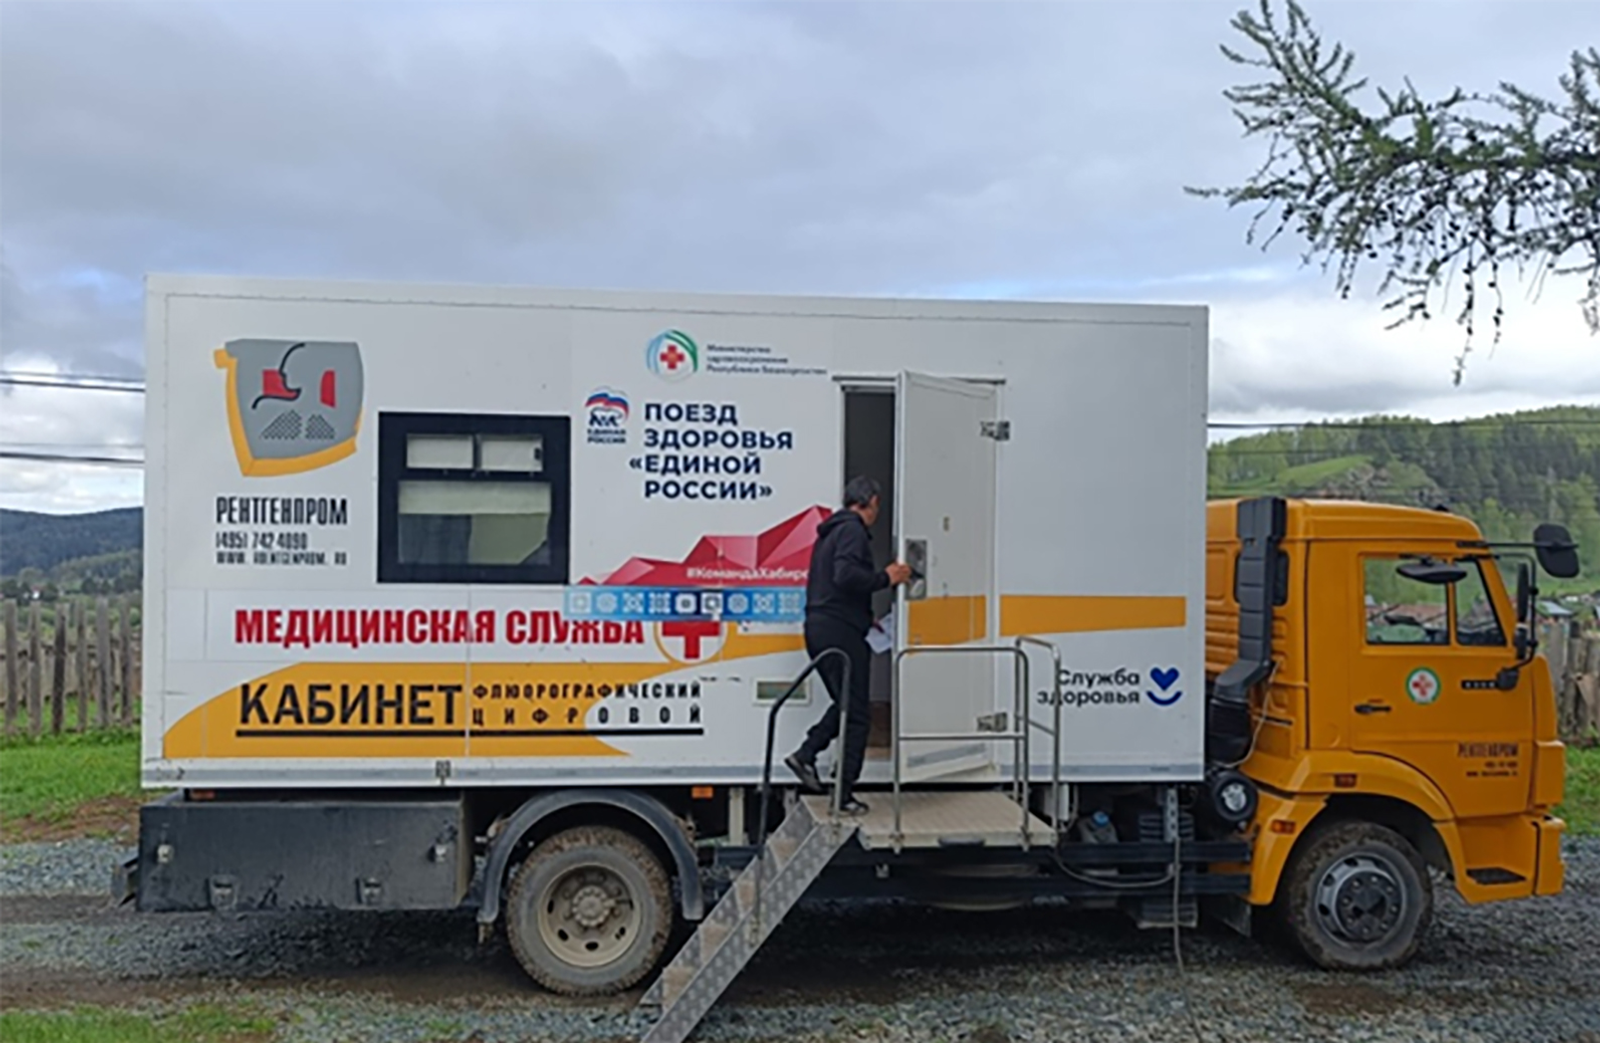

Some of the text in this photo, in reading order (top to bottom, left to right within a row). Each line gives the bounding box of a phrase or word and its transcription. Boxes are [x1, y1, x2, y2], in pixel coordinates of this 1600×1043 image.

[644, 403, 738, 426] ПОЕЗД
[643, 428, 793, 450] ЗДОРОВЬЯ
[629, 452, 761, 476] «ЕДИНОЙ
[644, 480, 772, 500] РОССИИ»
[216, 496, 348, 525] РЕНТГЕНПРОМ
[235, 609, 645, 649] МЕДИЦИНСКАЯ СЛУЖБА
[1057, 668, 1140, 688] Служба
[472, 681, 701, 699] ФЛЮОРОГРАФИЧЕСКИЙ
[1037, 690, 1140, 708] здоровья
[240, 683, 463, 725] КАБИНЕТ
